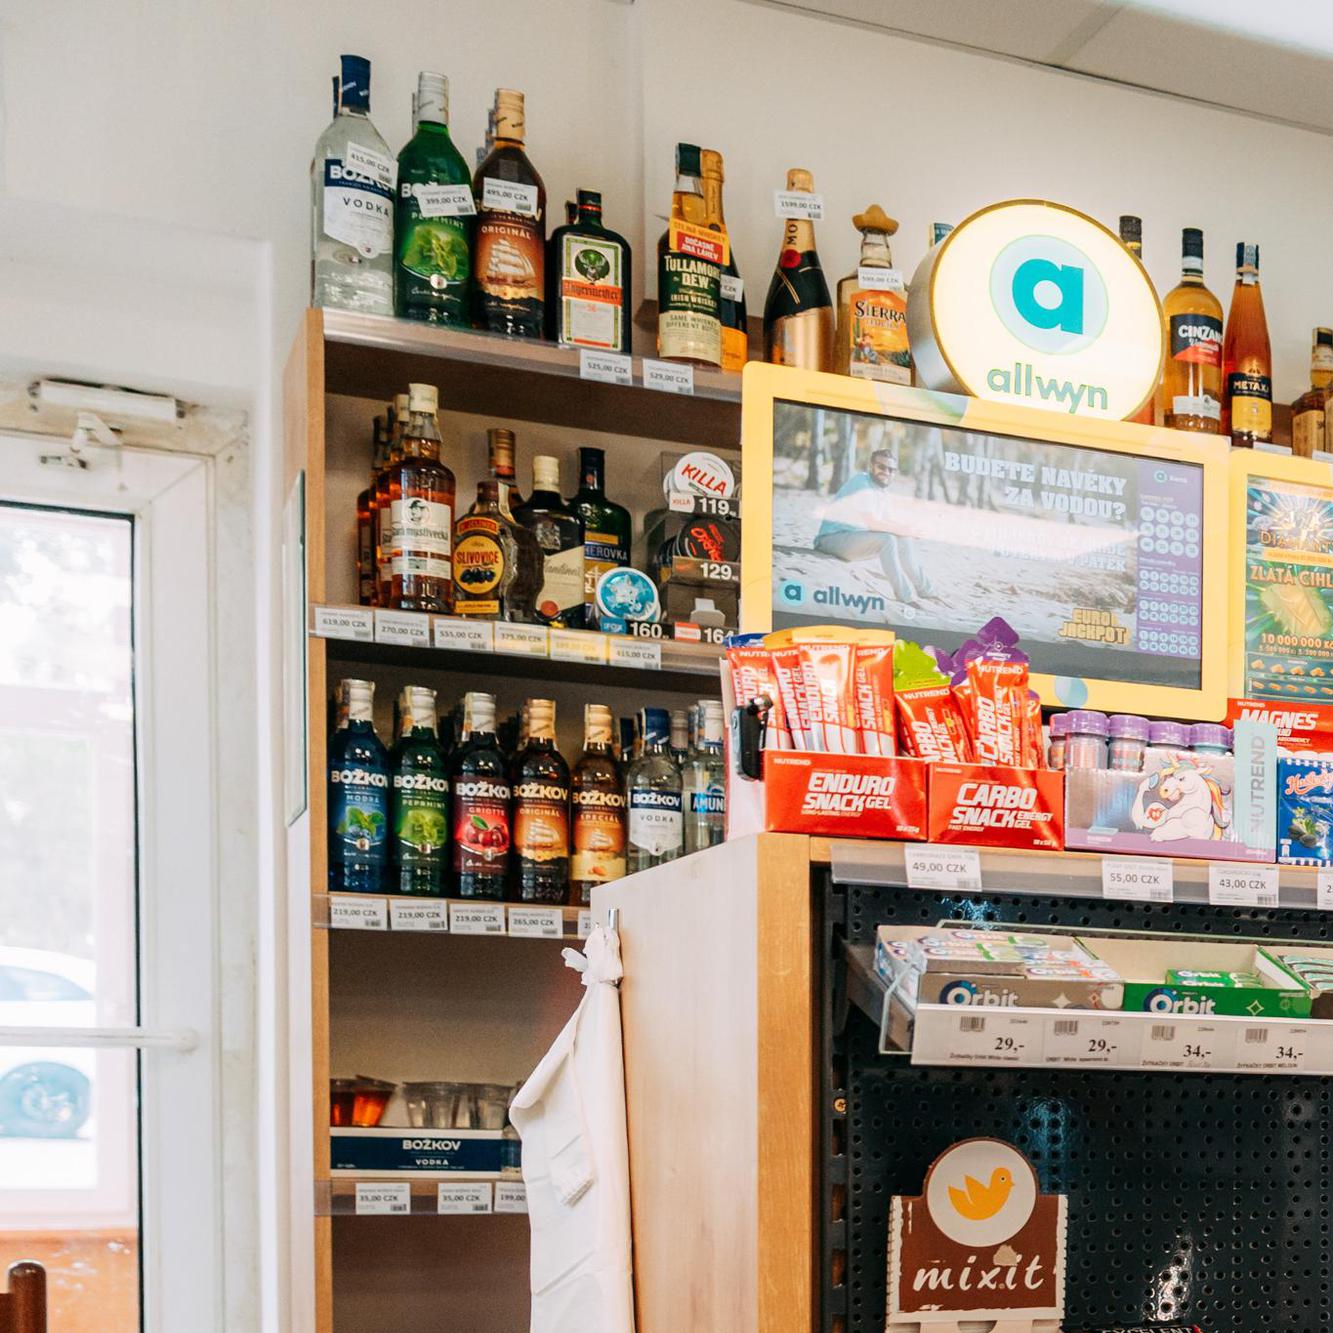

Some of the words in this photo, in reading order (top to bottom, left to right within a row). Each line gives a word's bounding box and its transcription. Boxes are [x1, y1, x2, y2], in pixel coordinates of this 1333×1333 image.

[343, 197, 390, 217] VODKA
[481, 224, 532, 240] ORIGINÁL
[682, 273, 709, 289] DEW
[854, 300, 906, 322] SIERRA
[675, 375, 690, 385] CZK
[987, 362, 1108, 414] allwyn
[682, 463, 726, 493] KILLA
[945, 452, 1035, 481] BUDETE
[1042, 465, 1127, 496] NAVĚKY
[700, 499, 729, 514] 119
[1005, 485, 1033, 507] ZA
[1039, 490, 1126, 520] VODOU?
[456, 550, 500, 565] SLIVOVICE
[1250, 565, 1294, 586] ZLATÁ
[813, 585, 885, 611] allwyn
[1058, 621, 1128, 644] JACKPOT
[1261, 633, 1274, 646] 10
[1277, 634, 1298, 648] 000
[1300, 636, 1322, 650] 000
[1239, 709, 1319, 731] MAGNES
[513, 781, 568, 801] BOŽKOV
[808, 772, 896, 795] ENDURO
[1249, 735, 1265, 834] NUTREND
[573, 789, 627, 806] BOŽKOV
[633, 791, 681, 807] BOŽKOV
[803, 792, 865, 812] SNACK
[865, 796, 892, 810] GEL
[957, 783, 1038, 810] CARBO
[469, 806, 506, 817] GRIOTTE
[519, 806, 560, 818] ORIGINÁL
[640, 814, 674, 823] VODKA
[951, 807, 1016, 829] SNACK
[1017, 811, 1054, 822] ENERGY
[1013, 819, 1033, 830] GEL
[913, 862, 943, 874] 49,00
[946, 863, 967, 873] CZK
[1110, 872, 1138, 884] 55,00
[1140, 874, 1160, 884] CZK
[1219, 878, 1247, 889] 43,00
[1248, 879, 1267, 889] CZK
[332, 907, 360, 918] 219,00
[362, 906, 379, 917] CZK
[940, 981, 1018, 1006] Orbit
[1145, 988, 1215, 1014] Orbit
[995, 1037, 1025, 1053] 29,-
[1184, 1045, 1212, 1060] 34,-
[403, 1139, 461, 1151] BOŽKOV
[913, 1254, 1045, 1291] mixit
